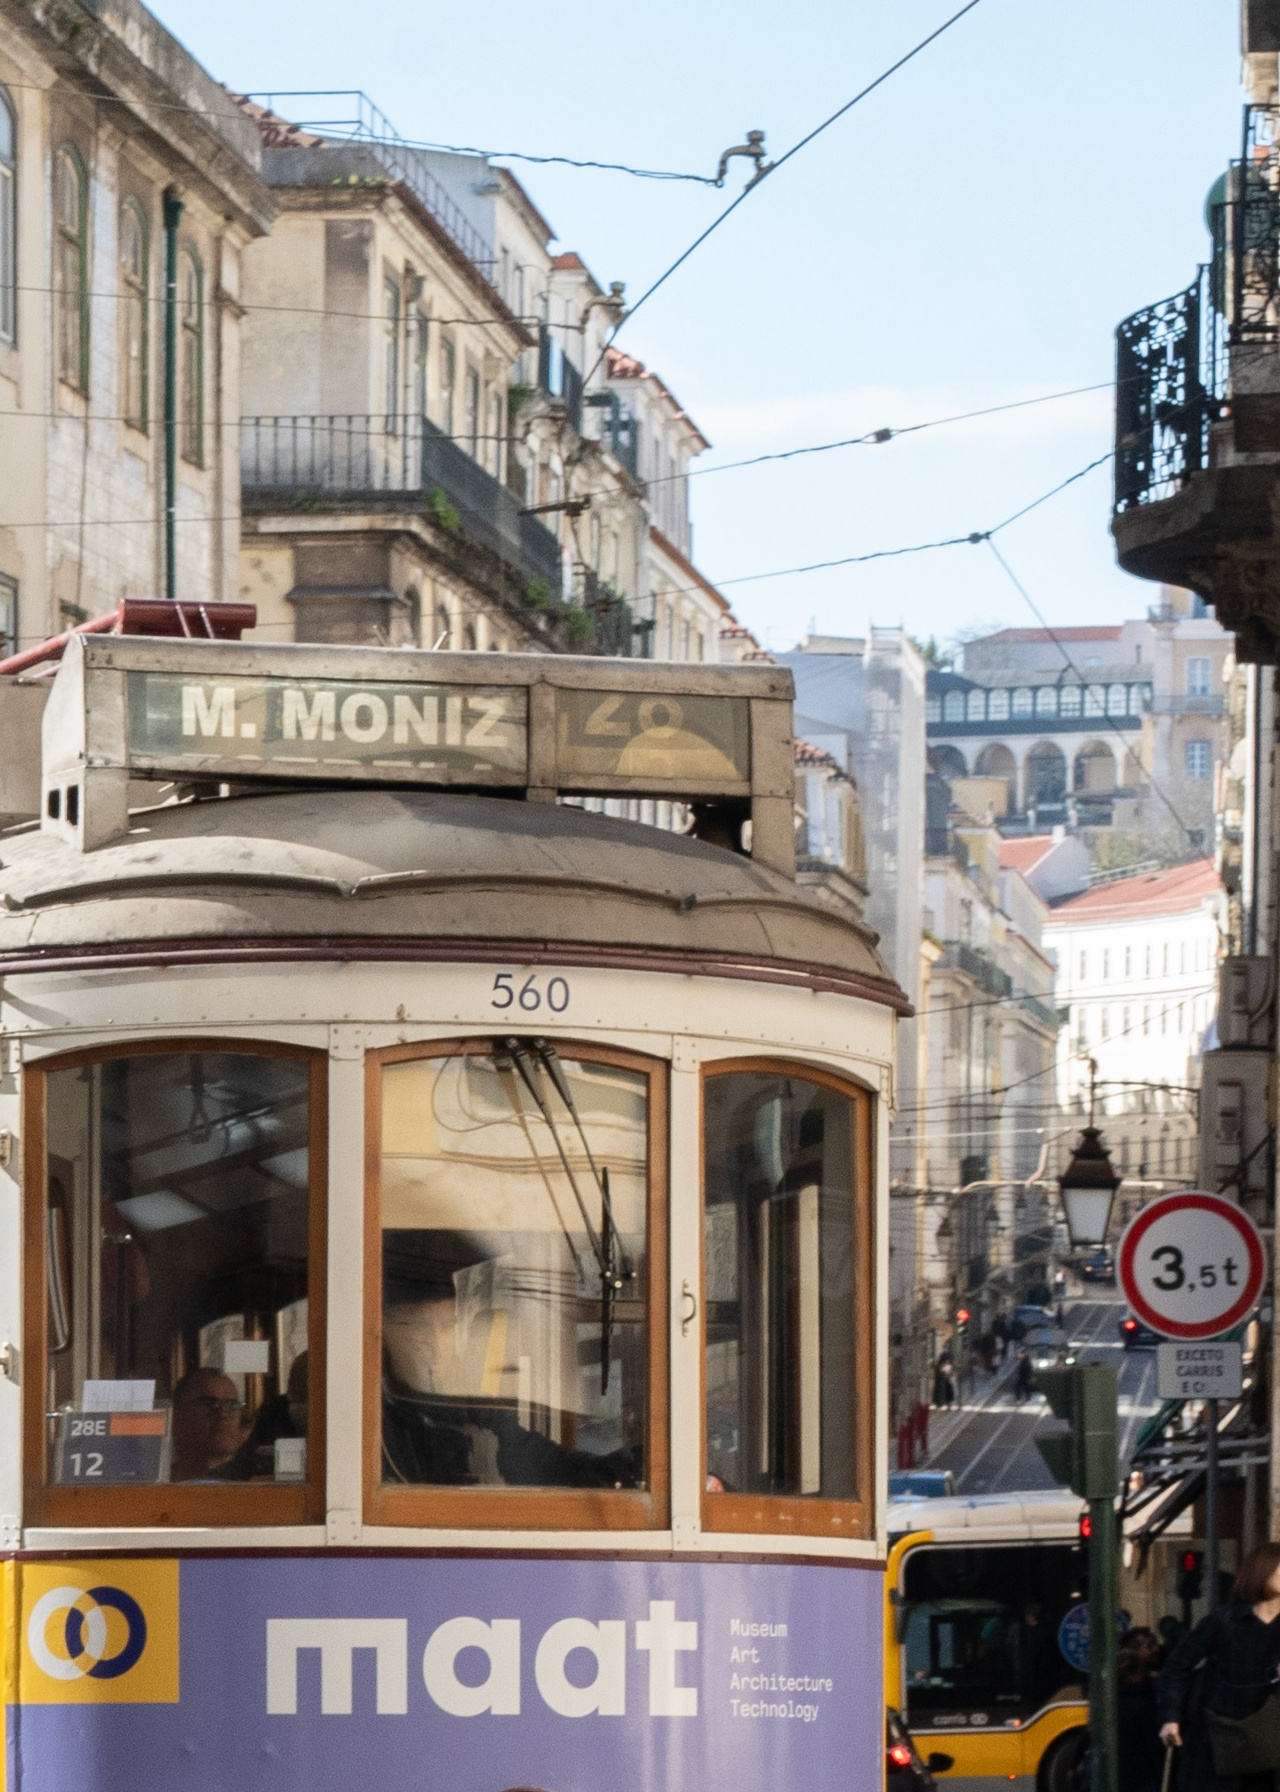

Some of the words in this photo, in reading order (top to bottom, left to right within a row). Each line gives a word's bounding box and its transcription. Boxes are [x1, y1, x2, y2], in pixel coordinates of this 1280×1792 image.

[181, 686, 257, 738] M.
[282, 689, 508, 747] MONIZ
[491, 973, 570, 1012] 560
[70, 1419, 107, 1437] 28E
[70, 1452, 104, 1477] 12
[730, 1618, 788, 1637] Museum
[266, 1600, 698, 1718] maat
[729, 1646, 760, 1664] Art
[729, 1672, 834, 1692] Architecture
[729, 1699, 820, 1722] Technology
